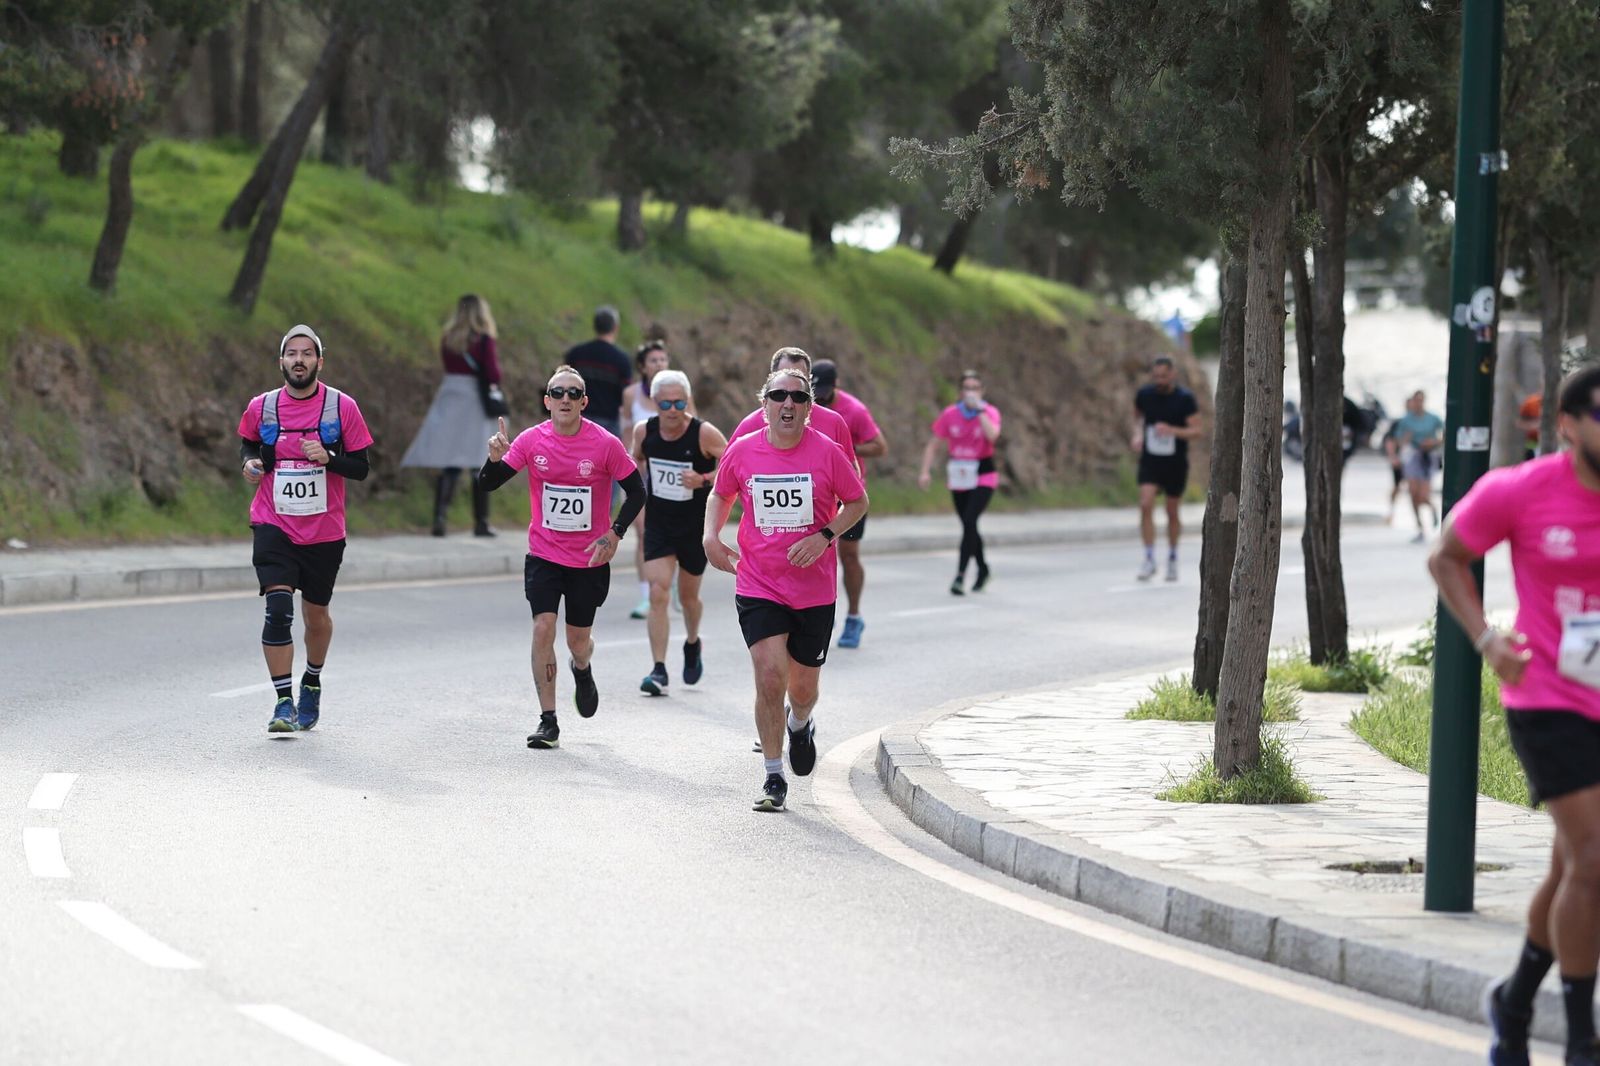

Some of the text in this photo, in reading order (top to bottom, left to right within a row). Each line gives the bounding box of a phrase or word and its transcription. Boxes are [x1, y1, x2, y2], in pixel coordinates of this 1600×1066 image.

[657, 470, 684, 486] 703
[282, 481, 319, 499] 401
[763, 489, 803, 508] 505
[549, 497, 584, 515] 720
